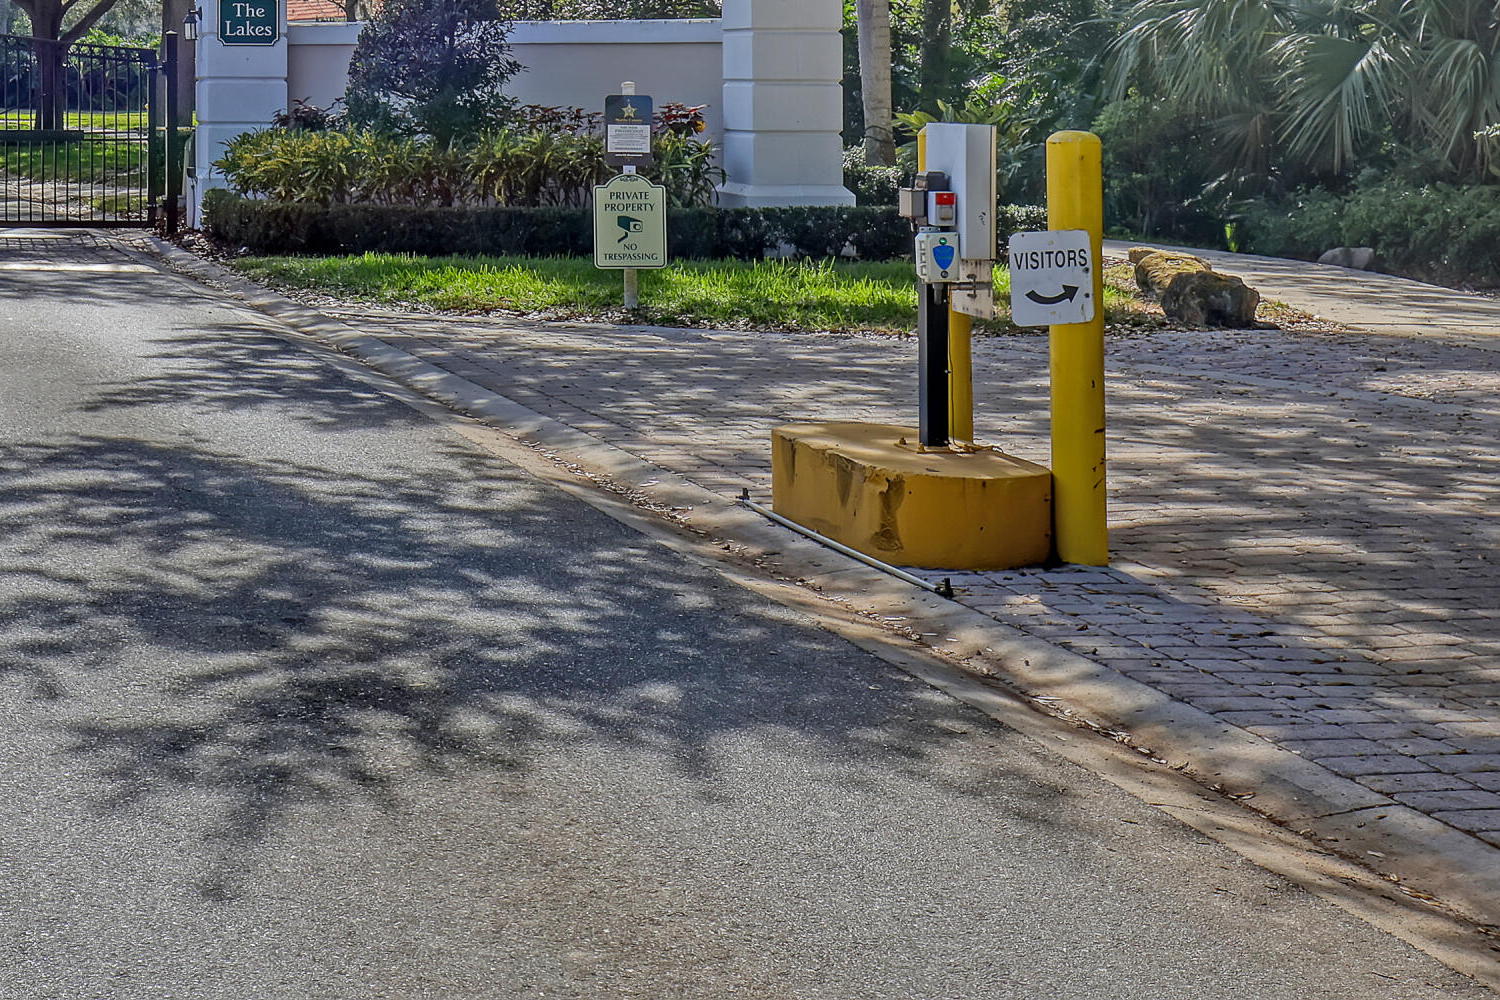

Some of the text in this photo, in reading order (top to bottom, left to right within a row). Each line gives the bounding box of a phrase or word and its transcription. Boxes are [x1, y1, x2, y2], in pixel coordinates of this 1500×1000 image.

[232, 2, 266, 18] The
[225, 20, 272, 36] Lakes
[609, 191, 650, 200] PRIVATE
[604, 203, 655, 212] PROPERTY
[623, 243, 638, 251] NO
[604, 253, 658, 261] TRESPASSING
[1014, 248, 1088, 270] VISITORS
